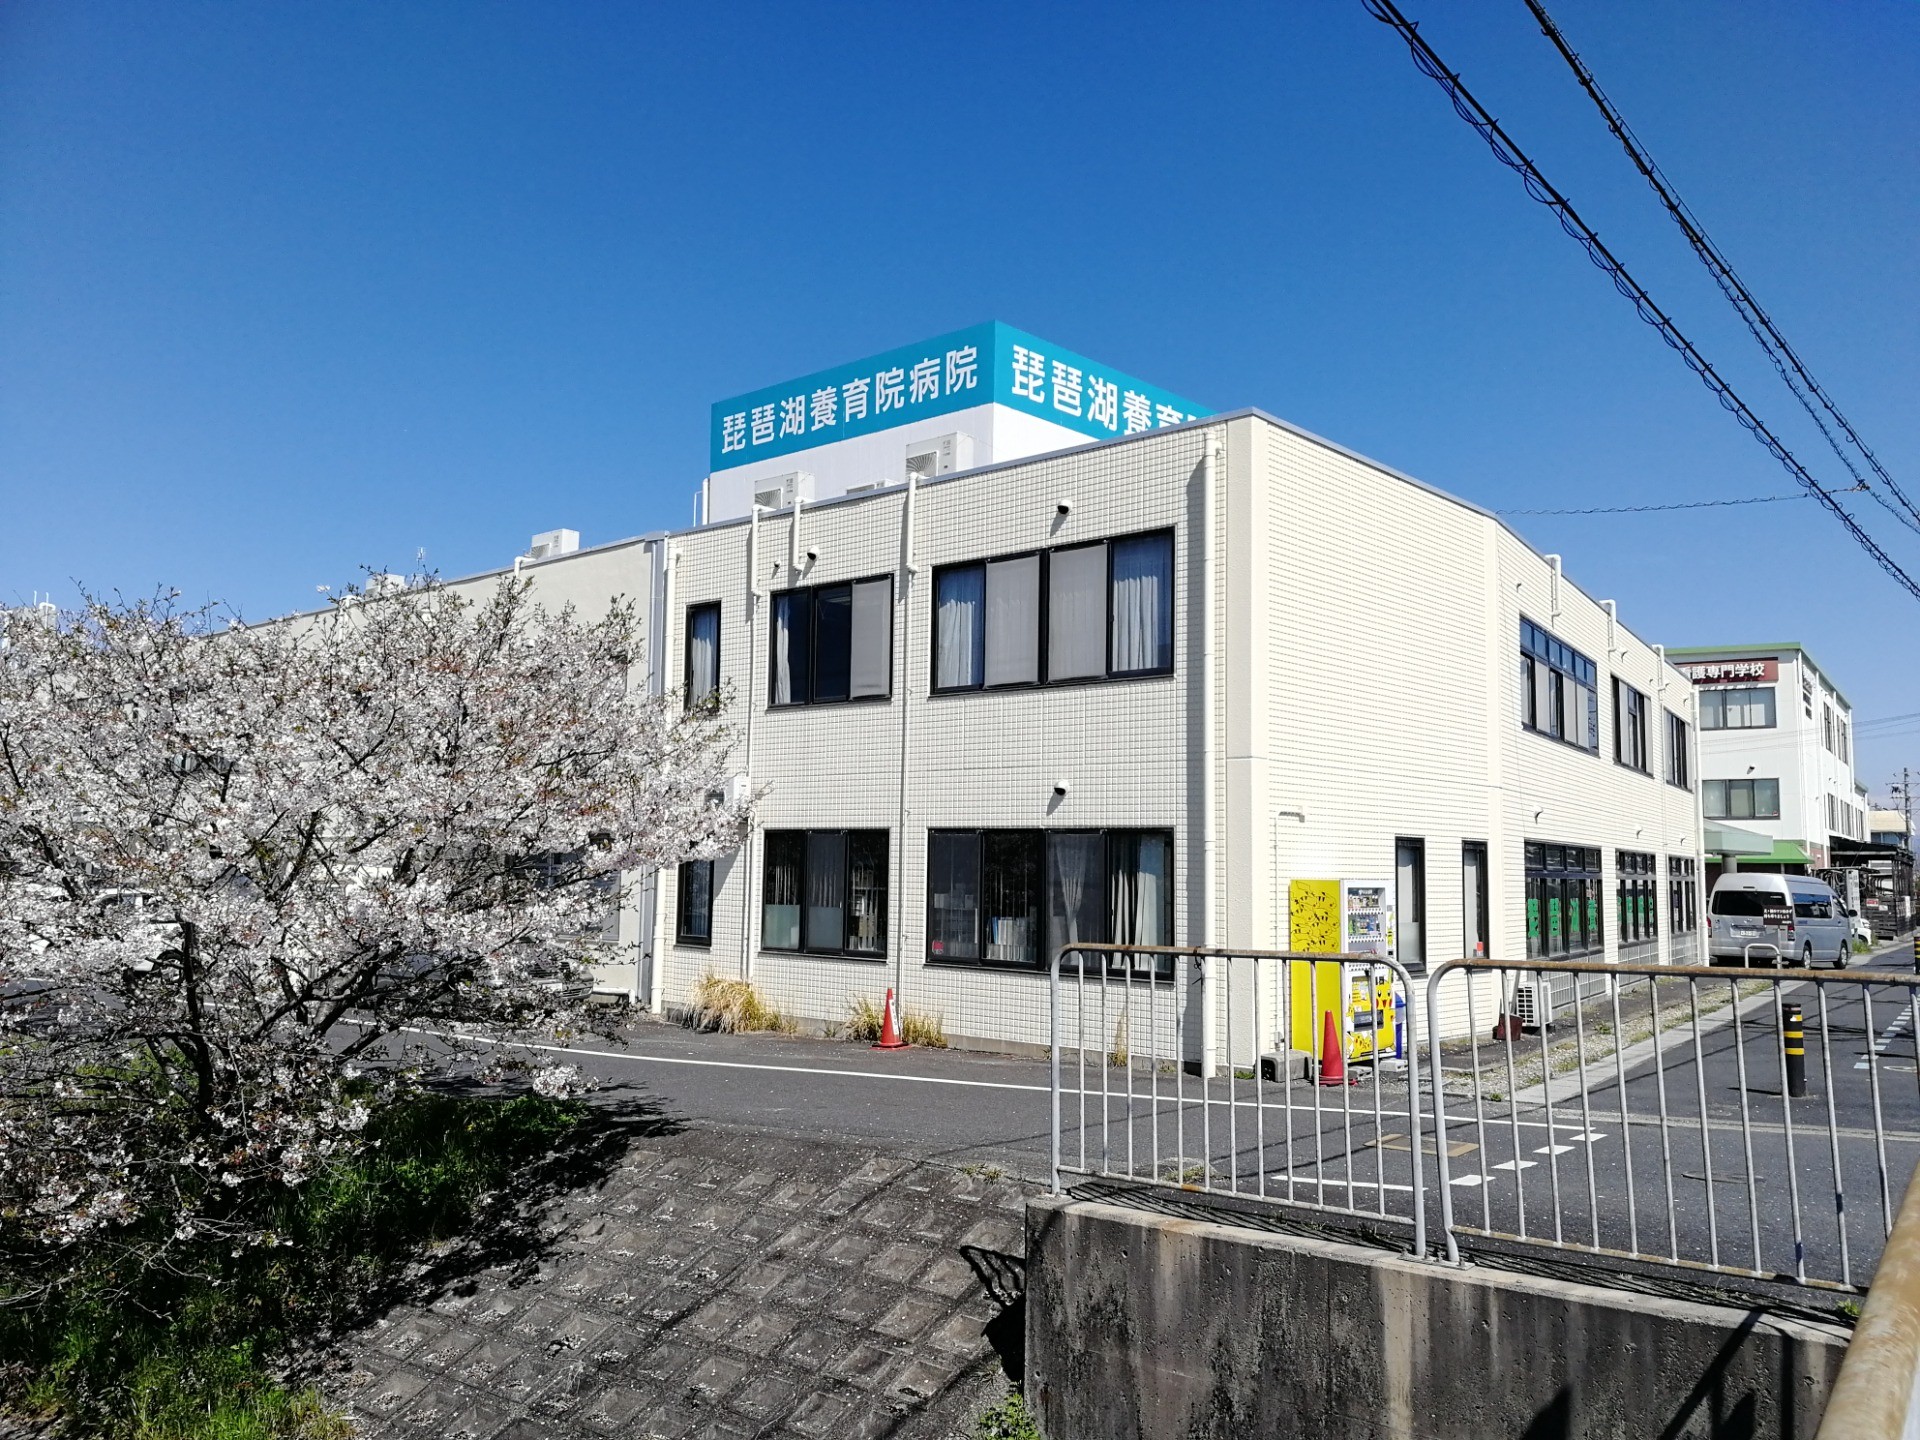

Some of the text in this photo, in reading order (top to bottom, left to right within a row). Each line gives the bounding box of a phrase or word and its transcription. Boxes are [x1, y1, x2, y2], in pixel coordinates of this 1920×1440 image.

[722, 345, 978, 454] 琵琶湖養育院病院
